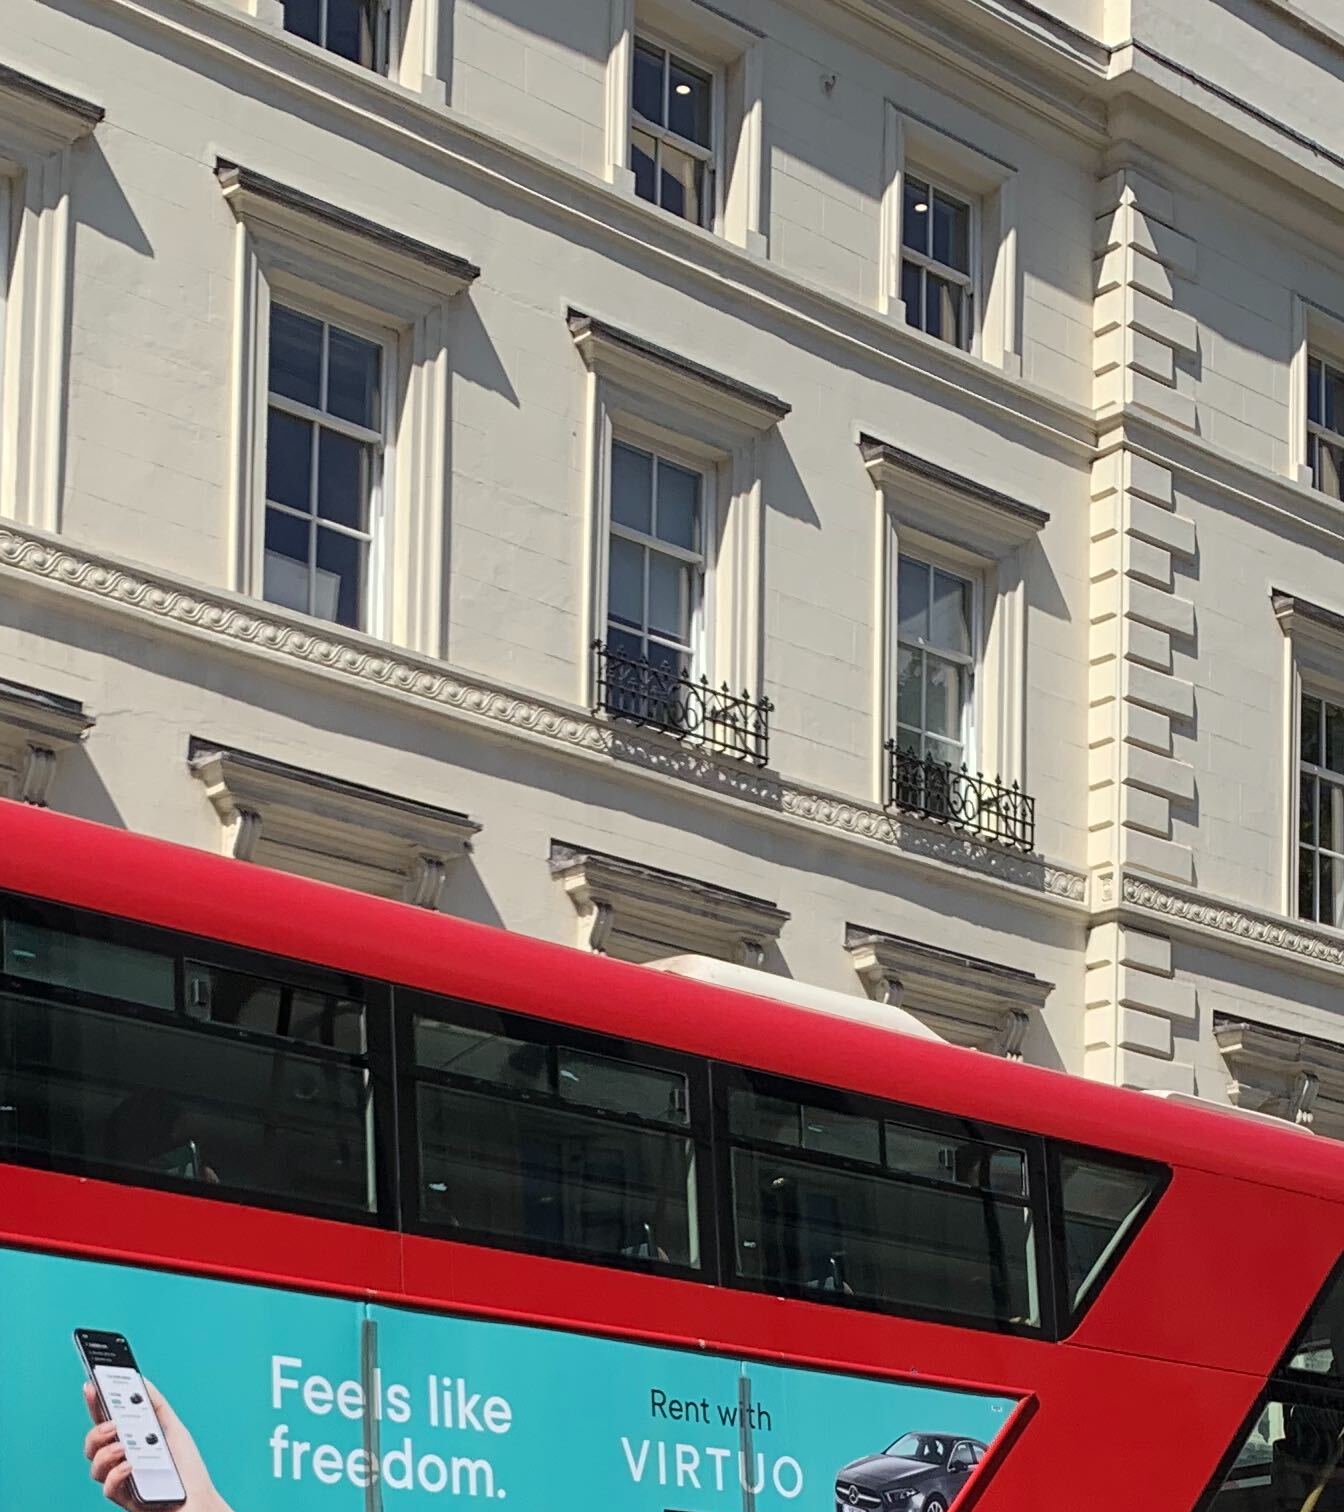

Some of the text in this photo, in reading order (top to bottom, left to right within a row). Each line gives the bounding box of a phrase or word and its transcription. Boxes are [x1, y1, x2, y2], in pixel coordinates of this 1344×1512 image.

[271, 1354, 513, 1434] Feels like
[650, 1388, 772, 1432] Rent with
[269, 1424, 507, 1500] freedom.
[620, 1436, 804, 1499] VIRTUO
